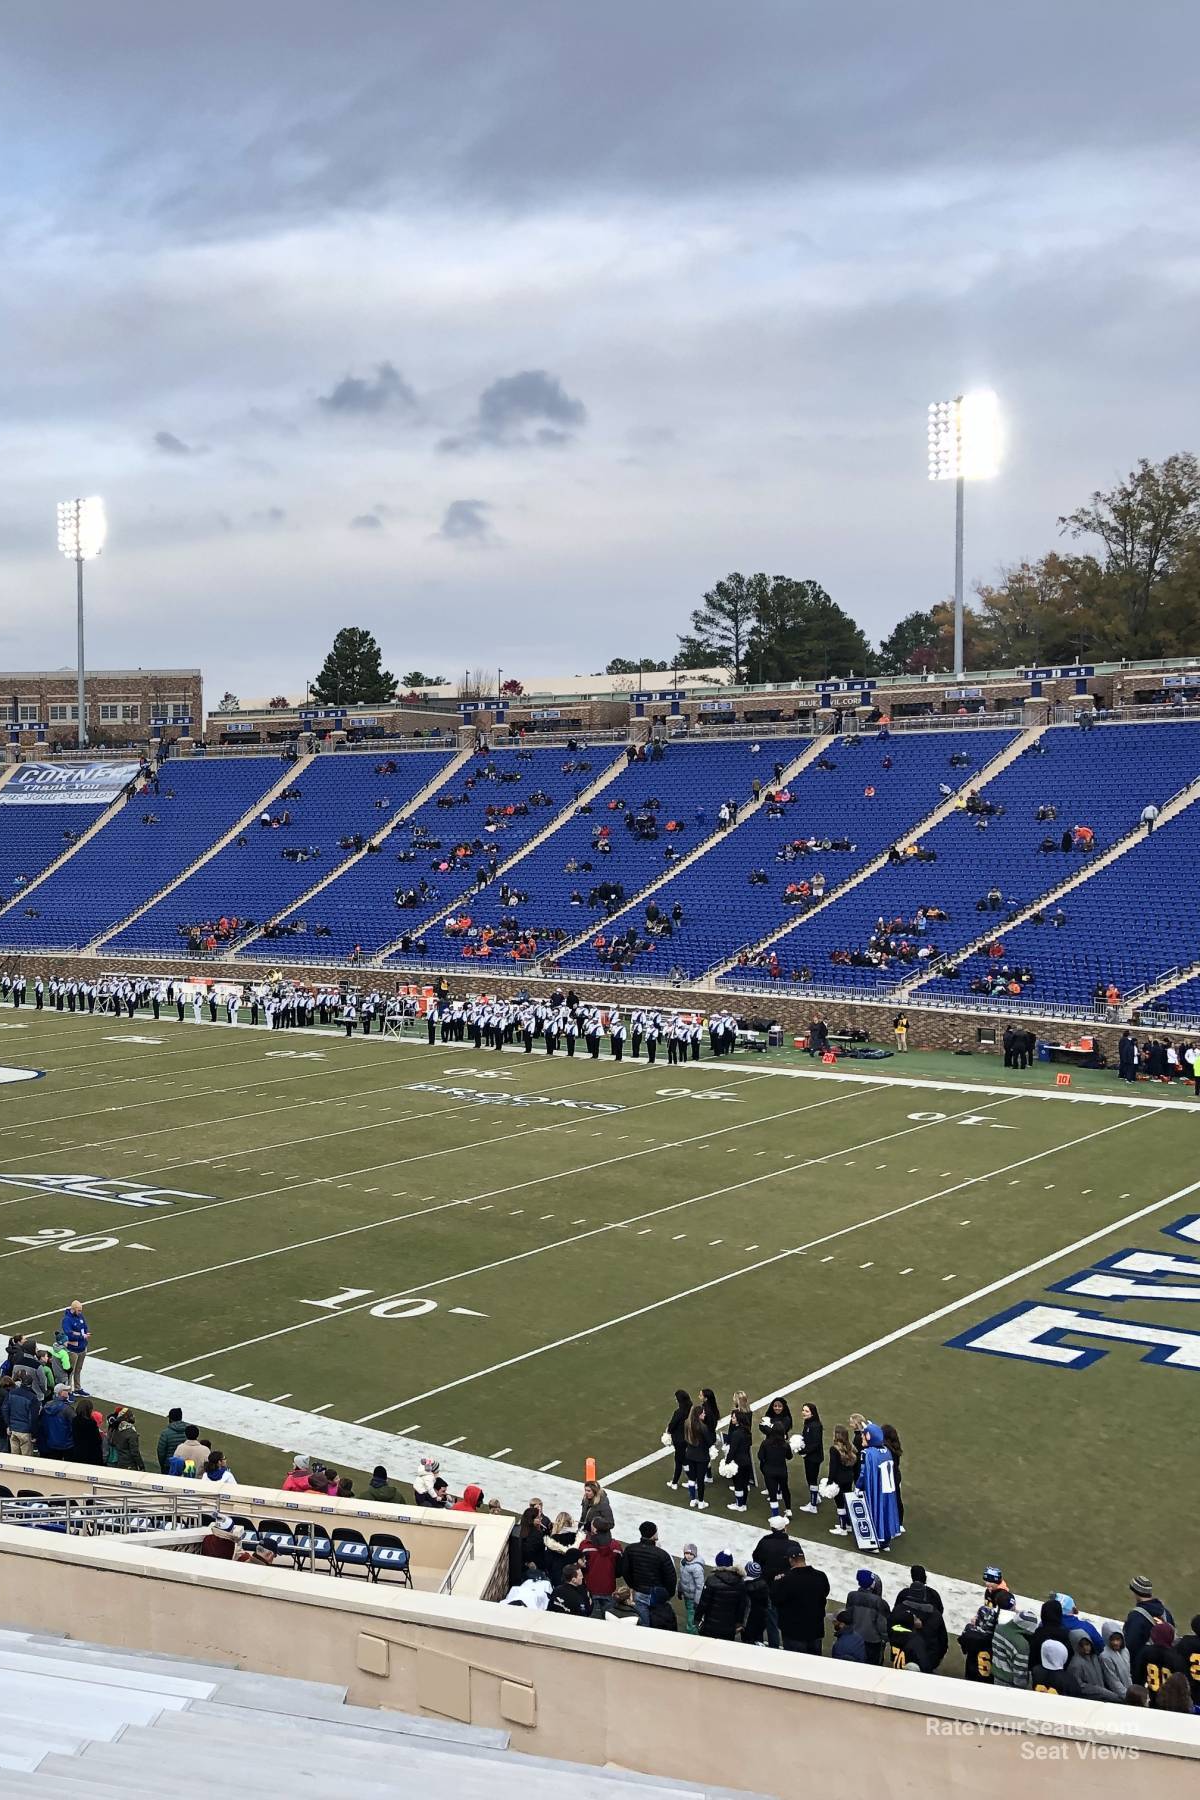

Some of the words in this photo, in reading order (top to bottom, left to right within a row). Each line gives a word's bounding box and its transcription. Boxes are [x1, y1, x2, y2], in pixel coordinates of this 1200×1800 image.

[18, 768, 128, 784] CORNER
[23, 784, 70, 792] Thank
[403, 1084, 632, 1111] BROOKS
[3, 1228, 120, 1252] 20
[298, 1286, 438, 1318] 10
